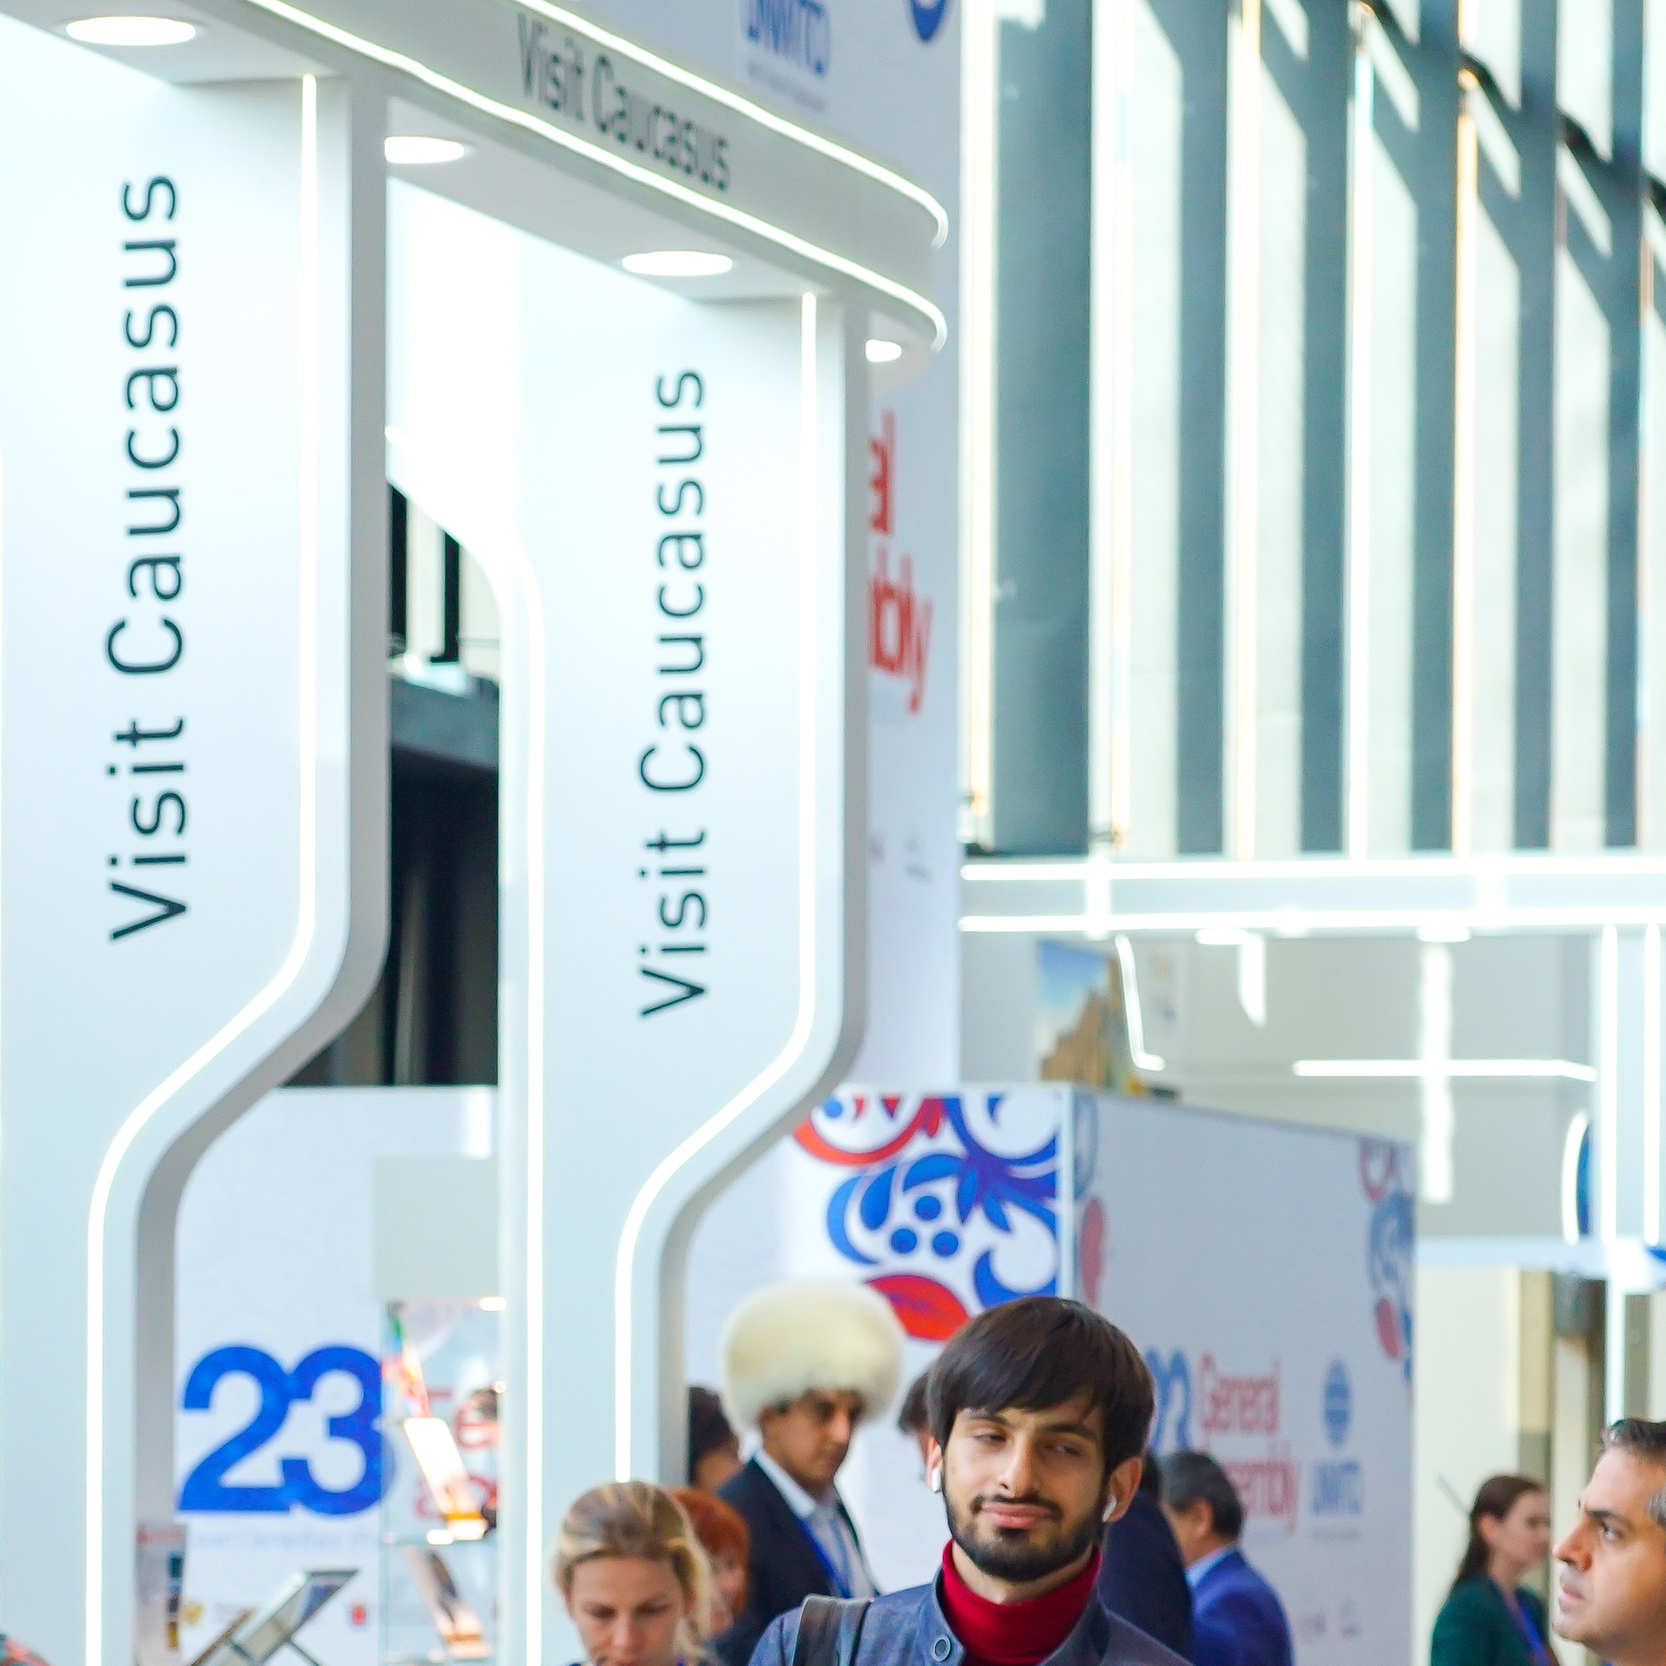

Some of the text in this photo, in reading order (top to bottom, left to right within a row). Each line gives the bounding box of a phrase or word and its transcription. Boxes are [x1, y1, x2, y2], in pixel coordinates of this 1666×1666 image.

[517, 11, 584, 123] Visit
[592, 53, 731, 192] Caucasus
[104, 174, 189, 943] Visit Caucasus
[637, 368, 709, 1020] Visit Caucasus
[178, 1345, 395, 1516] 23
